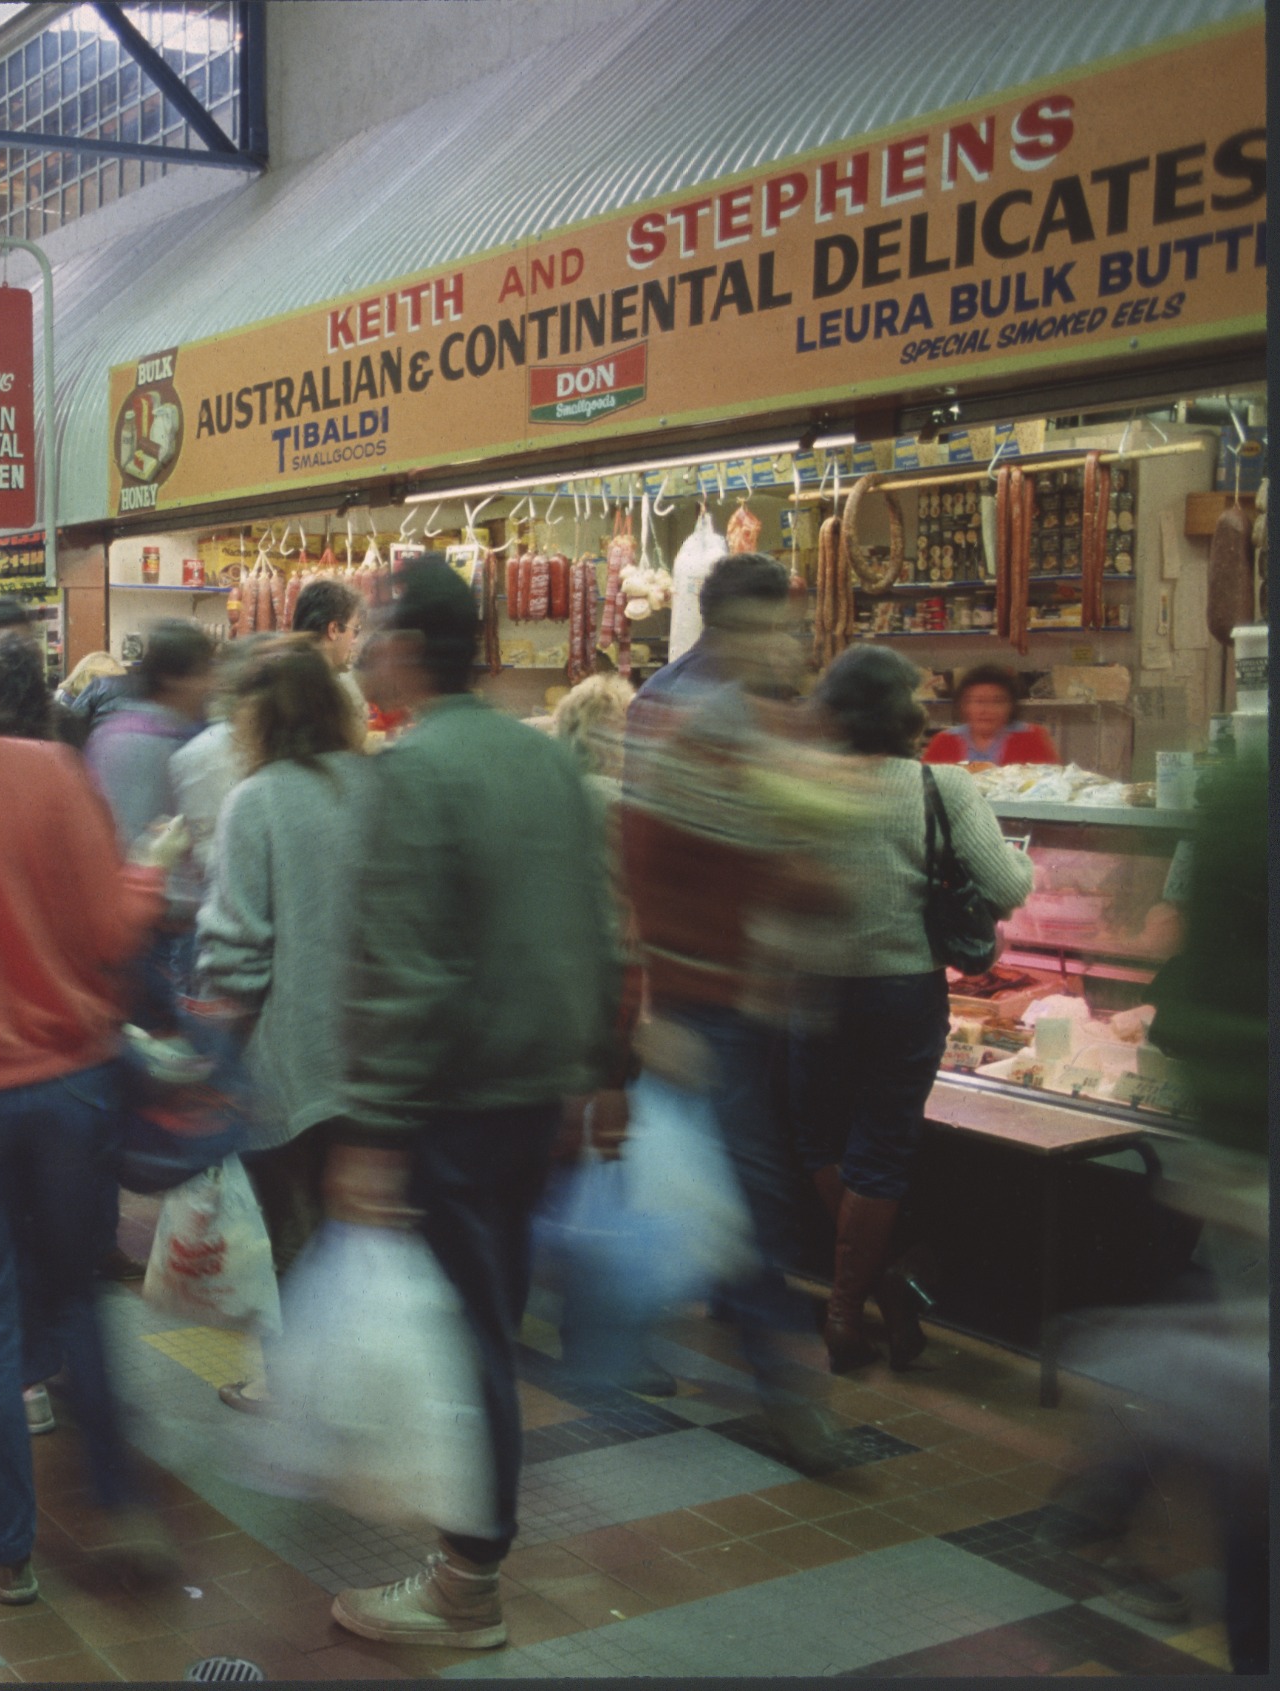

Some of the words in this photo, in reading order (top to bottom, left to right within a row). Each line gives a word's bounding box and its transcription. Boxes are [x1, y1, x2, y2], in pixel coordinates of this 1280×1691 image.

[327, 272, 464, 354] KEITH
[497, 247, 585, 303] AND
[626, 94, 1077, 271] STEPHENS
[795, 292, 933, 354] LEURA
[948, 260, 1077, 326] BULK
[898, 323, 992, 366] SPECIAL
[996, 305, 1108, 346] SMOKED
[1110, 291, 1187, 329] EELS
[138, 355, 173, 385] BULK
[195, 346, 403, 440] AUSTRALIAN
[408, 350, 431, 393] &
[439, 249, 793, 383] CONTINENTAL
[555, 361, 615, 399] DON
[555, 392, 616, 421] Smallgoods
[270, 406, 390, 474] TIBALDI
[290, 439, 388, 472] SMALLGOODS
[121, 483, 158, 511] HONEY
